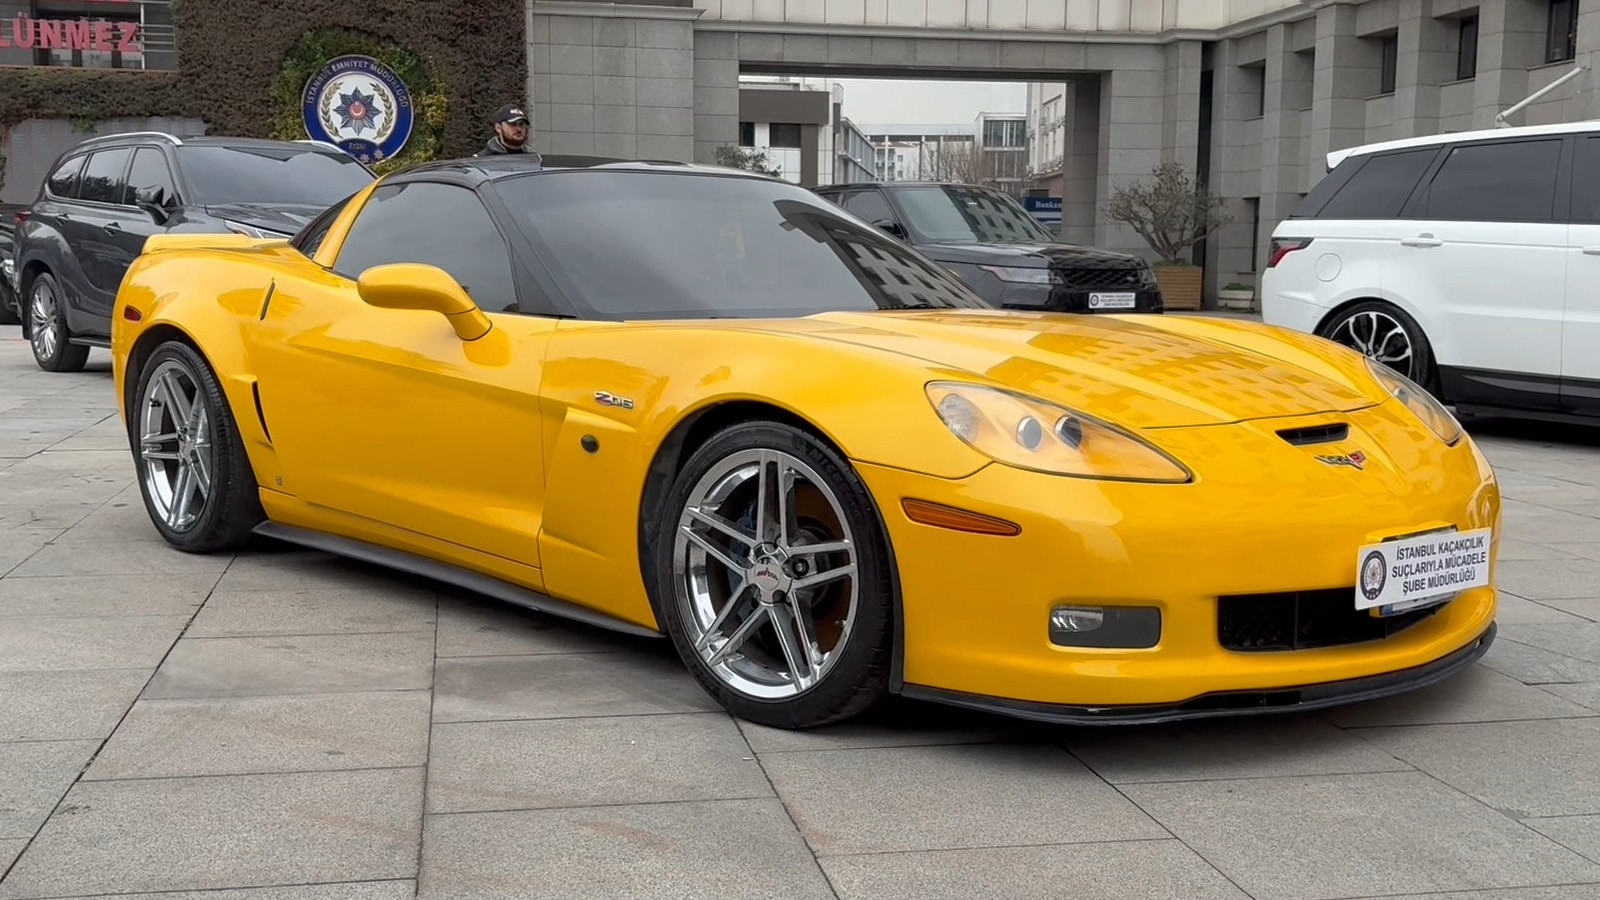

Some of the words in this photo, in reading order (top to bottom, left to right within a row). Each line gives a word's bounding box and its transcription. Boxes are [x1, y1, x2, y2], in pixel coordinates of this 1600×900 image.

[1396, 544, 1436, 560] İSTANBUL
[1438, 536, 1484, 556] KAÇAKÇILIK
[1391, 560, 1444, 579] SUÇLARIYLA
[1445, 551, 1486, 569] MÜCADELE
[1402, 580, 1426, 596] ŞUBE
[1427, 568, 1476, 588] MÜDÜRLÜĞÜ
